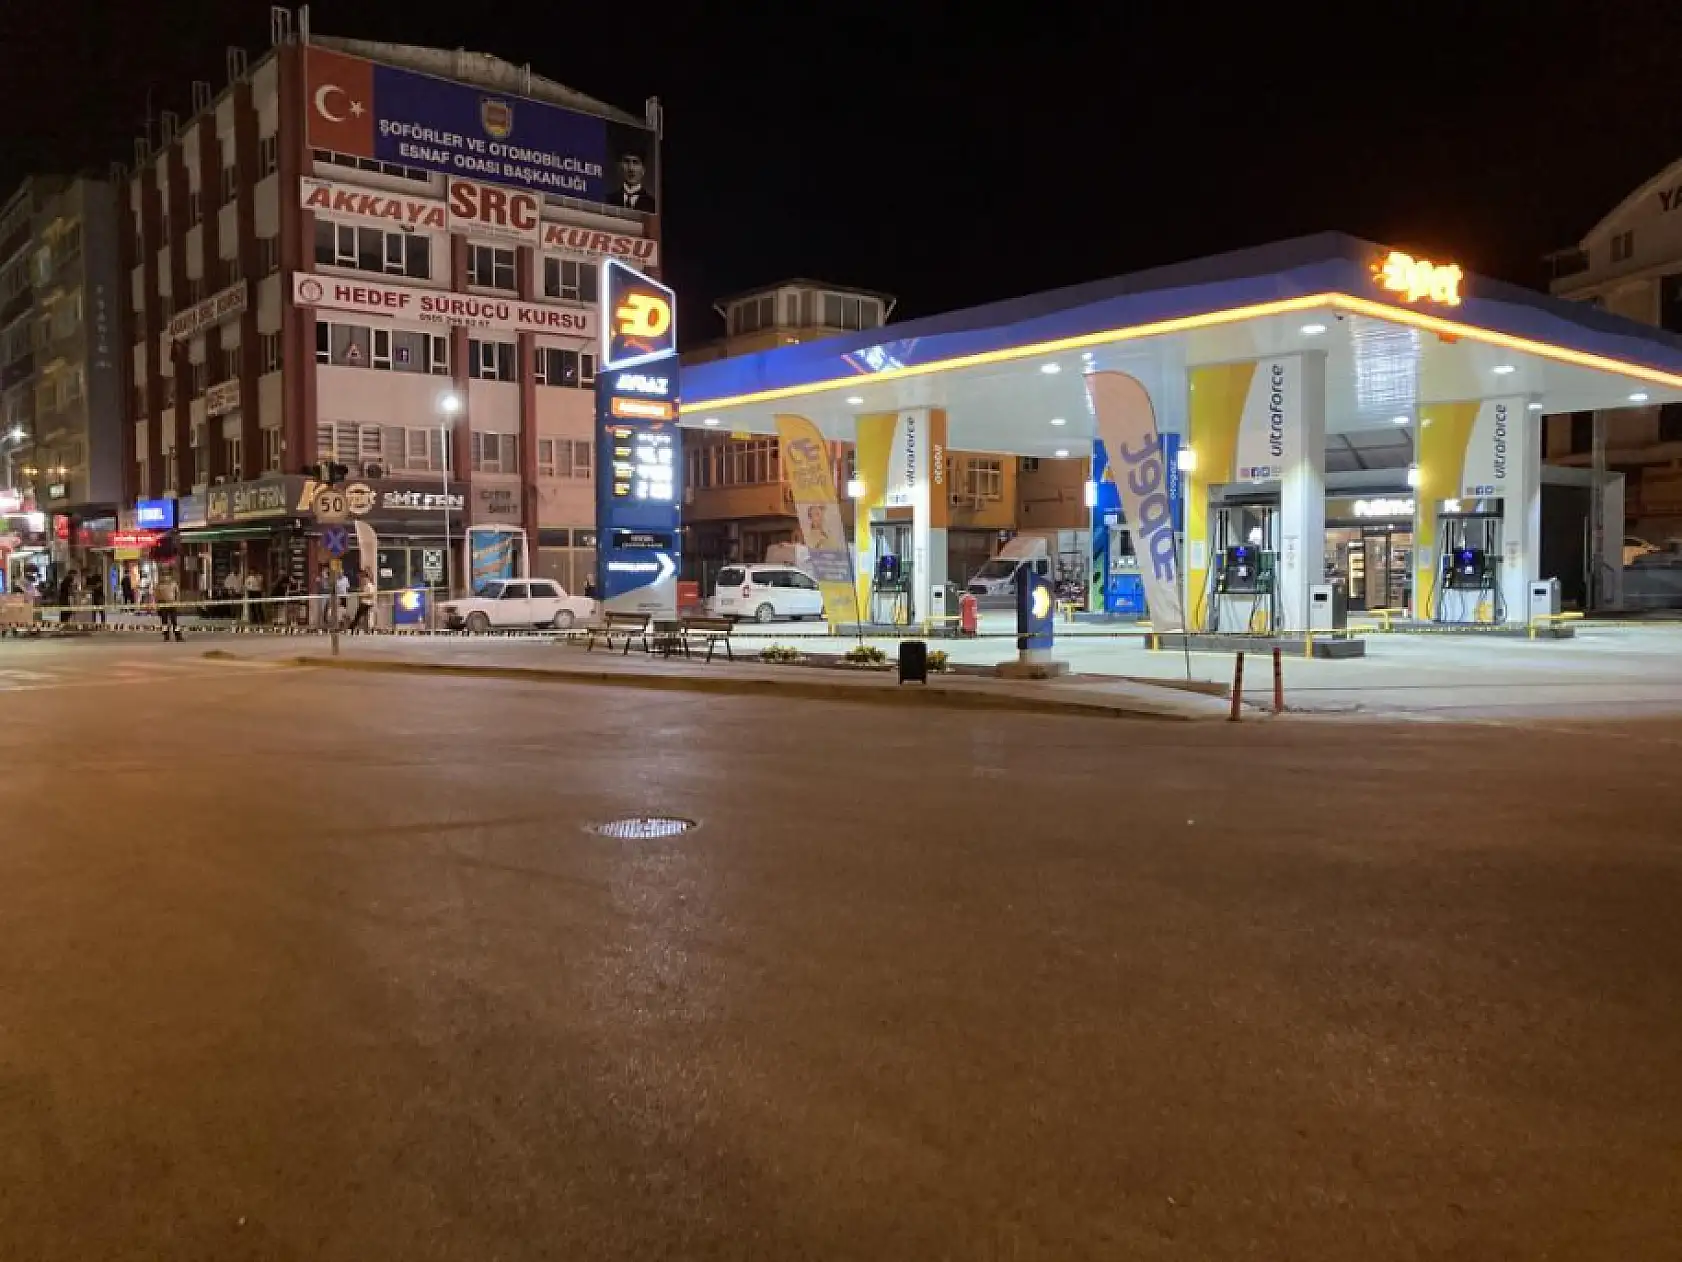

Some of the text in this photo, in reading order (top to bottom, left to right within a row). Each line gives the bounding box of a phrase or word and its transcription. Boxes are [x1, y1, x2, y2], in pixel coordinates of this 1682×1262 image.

[378, 118, 603, 178] ŞOFÖRLER VE OTOMOBİLCİLER
[400, 143, 587, 192] ESNAF ODASI BAŞKANLIĞI
[306, 187, 445, 228] AKKAYA
[450, 182, 537, 231] SRC
[545, 225, 655, 258] KURSU
[334, 284, 587, 330] HEDEF SÜRÜCÜ KURSU
[321, 497, 343, 512] 50
